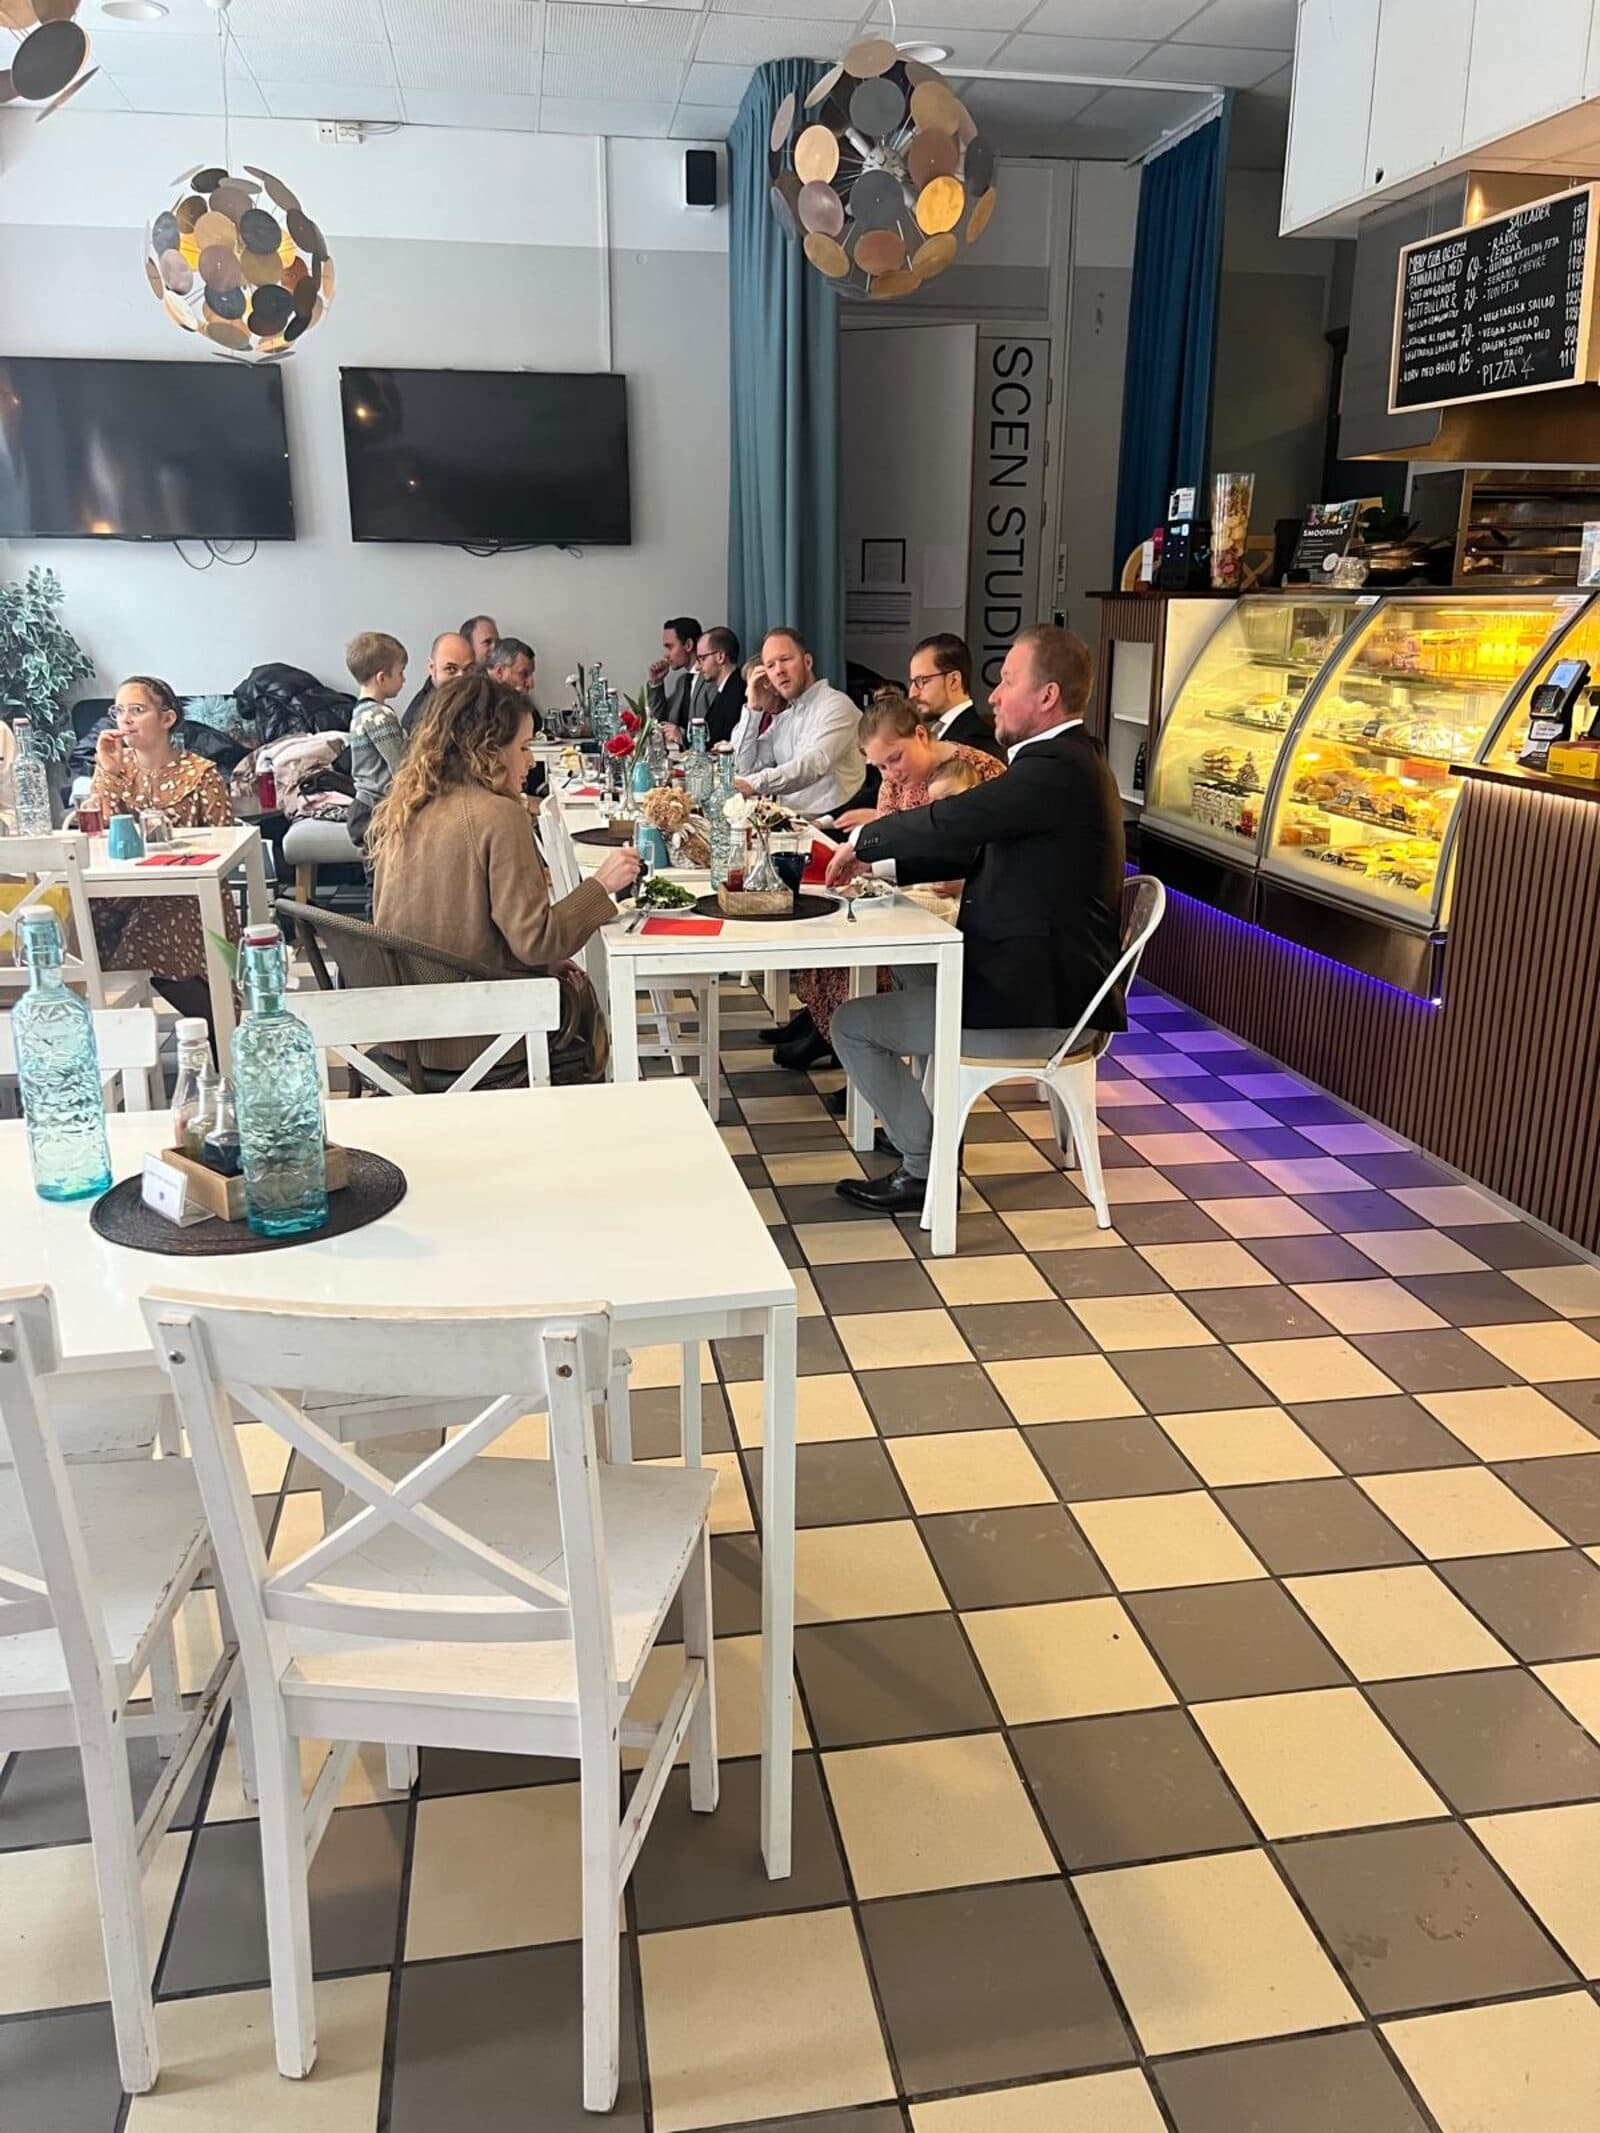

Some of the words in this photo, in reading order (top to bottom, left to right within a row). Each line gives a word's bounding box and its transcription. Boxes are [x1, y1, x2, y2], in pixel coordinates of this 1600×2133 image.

[1507, 203, 1551, 233] SALLADER
[1447, 259, 1463, 277] MED
[1483, 303, 1525, 322] VEGETARISK
[1528, 294, 1555, 312] SALLAD
[1482, 327, 1505, 337] VEGAN
[1507, 315, 1540, 333] SALLAD
[1508, 333, 1533, 346] SOPPA
[1534, 328, 1551, 341] MED
[1436, 360, 1456, 375] BRÖD
[1482, 360, 1517, 387] PIZZA
[989, 344, 1033, 487] SCEN
[1303, 528, 1344, 537] SMOOTHIES
